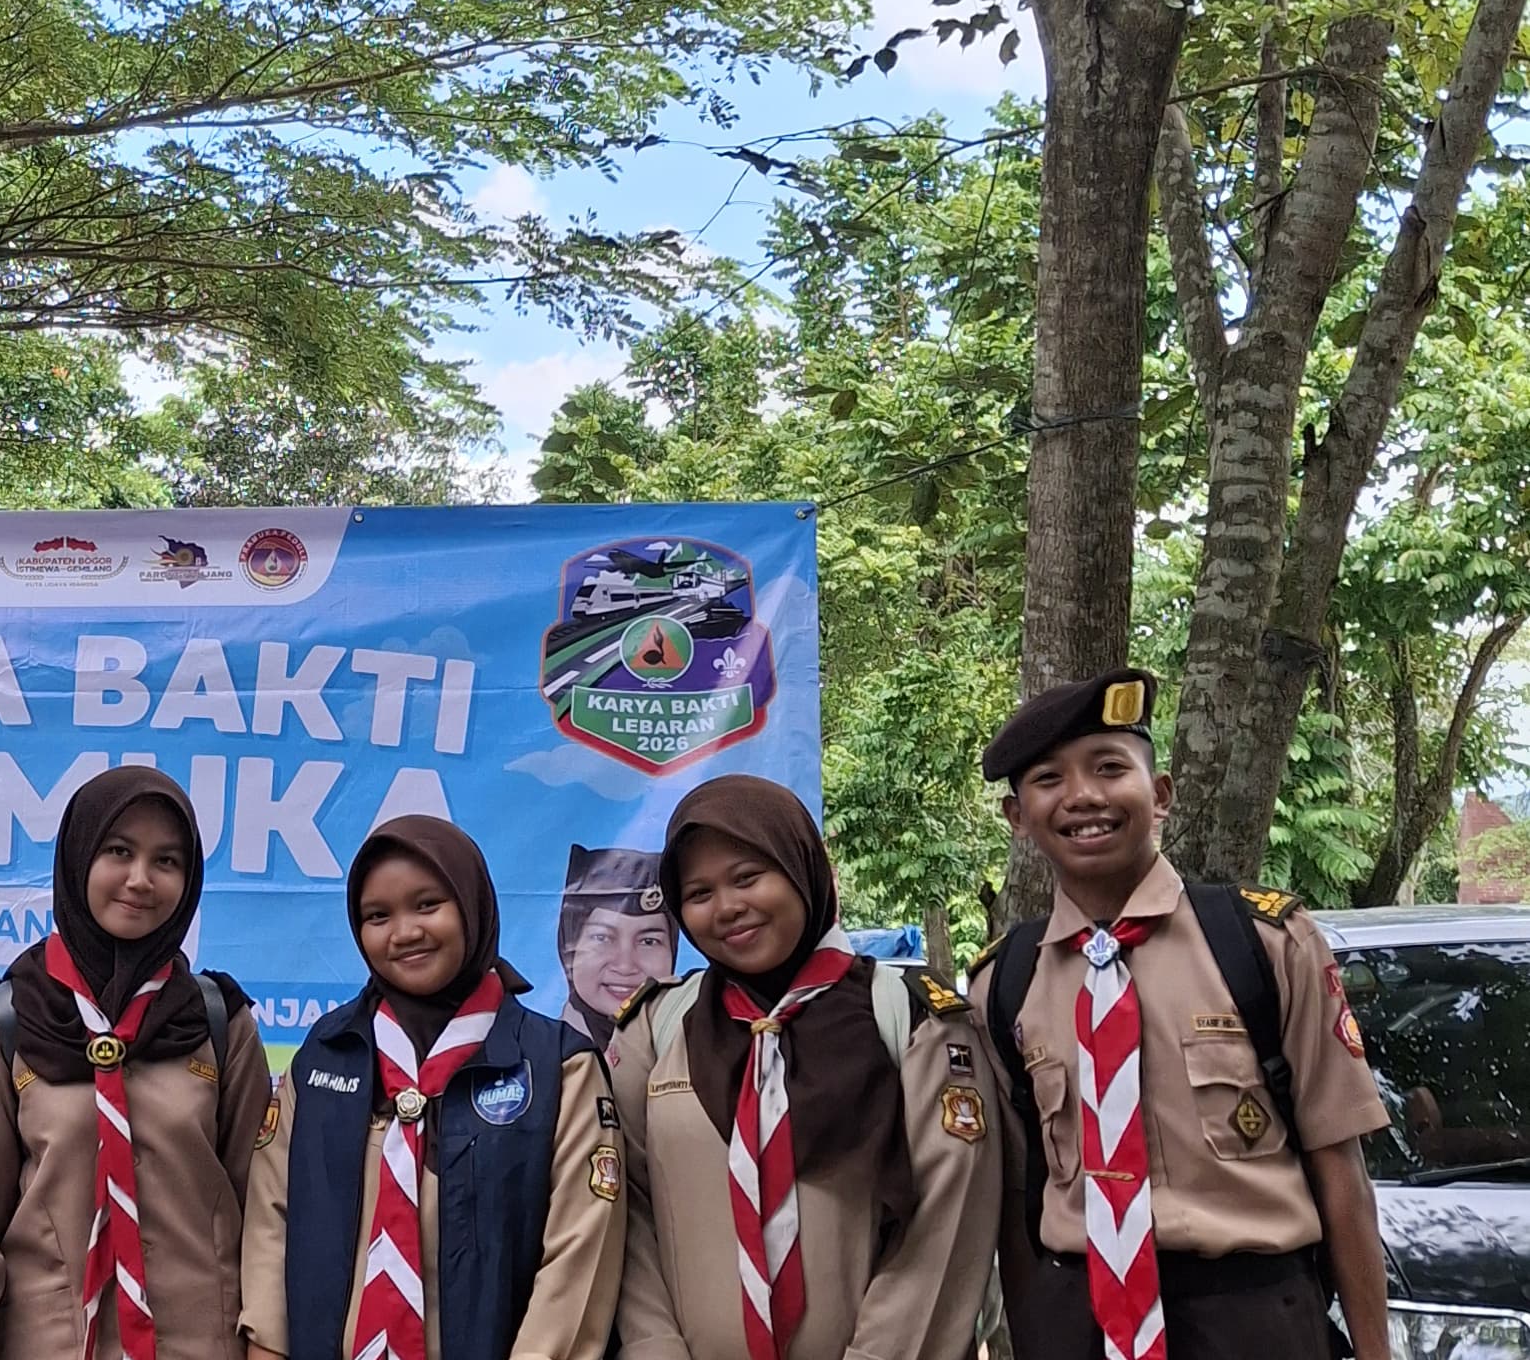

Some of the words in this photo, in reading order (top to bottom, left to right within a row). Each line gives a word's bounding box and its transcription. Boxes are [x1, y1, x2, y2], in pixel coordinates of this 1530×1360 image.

[19, 557, 76, 565] KABUPATEN
[78, 557, 113, 565] BOGOR
[72, 634, 475, 755] BAKTI
[587, 693, 664, 715] KARYA
[672, 692, 740, 715] BAKTI
[612, 716, 715, 735] LEBARAN
[637, 735, 690, 752] 2026
[477, 1085, 525, 1105] HUMAS
